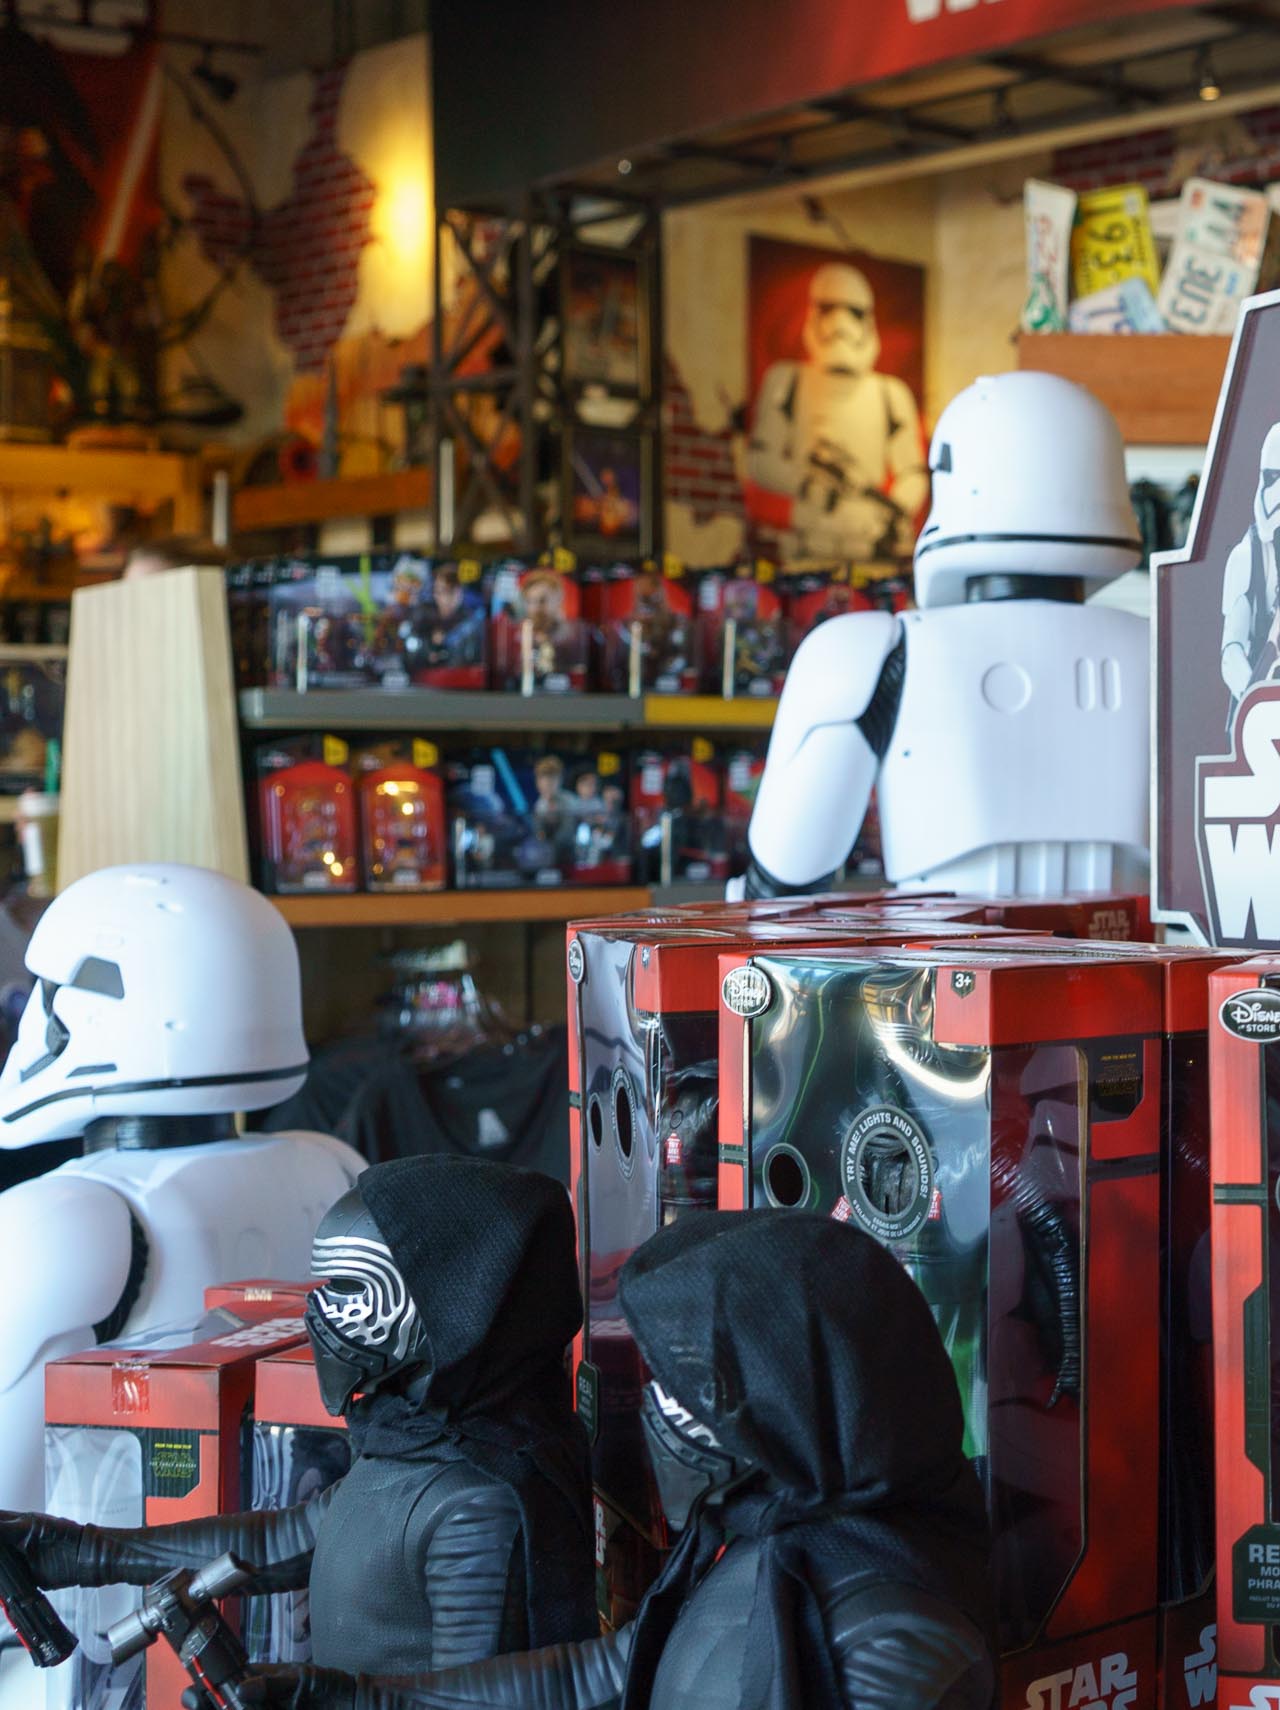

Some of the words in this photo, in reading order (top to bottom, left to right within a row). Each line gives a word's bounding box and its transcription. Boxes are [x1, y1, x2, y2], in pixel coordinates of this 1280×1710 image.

[955, 973, 972, 988] 3+
[1246, 1024, 1276, 1032] STORE
[859, 1112, 891, 1133] LIGHTS
[892, 1115, 912, 1137] AND
[848, 1131, 861, 1155] ME!
[847, 1157, 855, 1183] TRY
[911, 1136, 929, 1198] SOUNDS!
[1022, 1652, 1137, 1710] STAR
